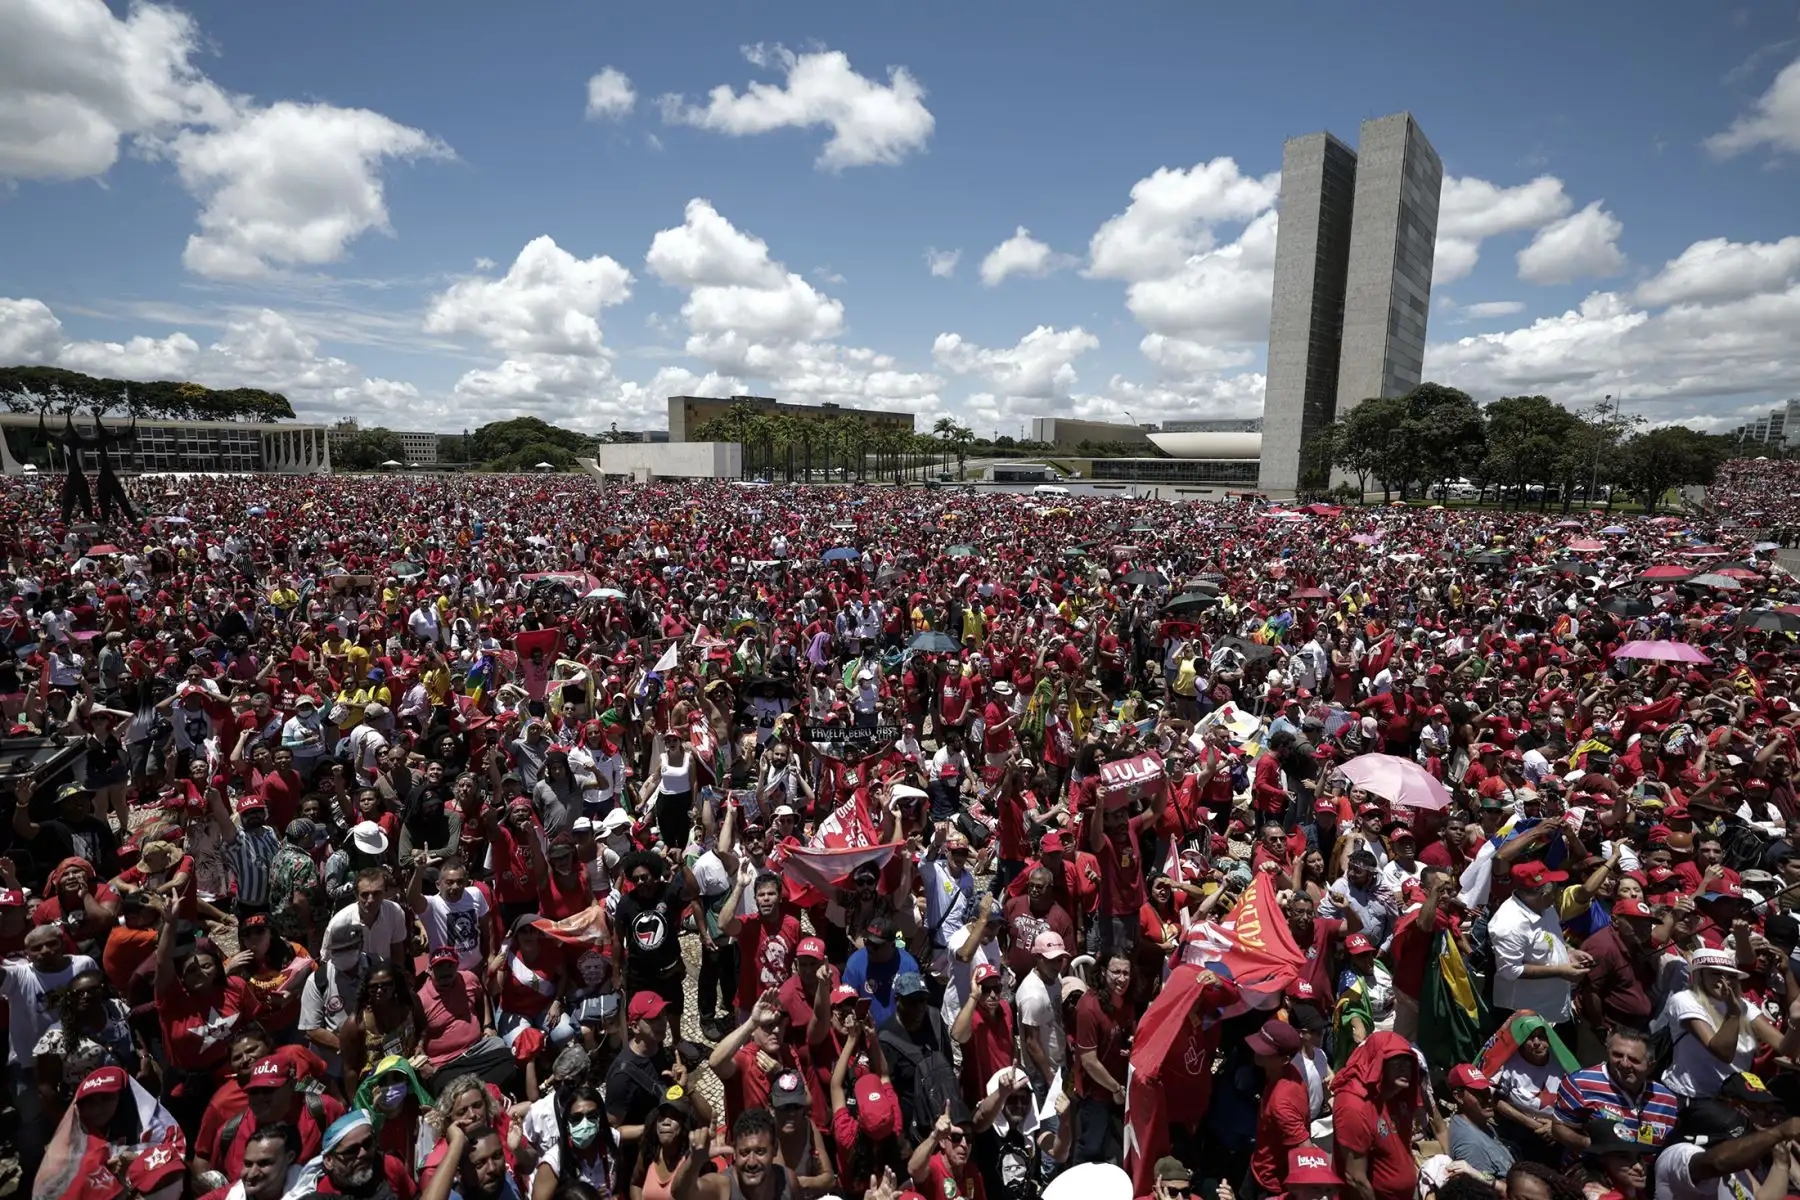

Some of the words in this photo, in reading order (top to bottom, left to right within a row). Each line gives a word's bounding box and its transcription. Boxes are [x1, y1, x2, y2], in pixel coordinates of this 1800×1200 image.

[811, 728, 846, 739] FAVELA
[1103, 756, 1161, 783] LULA
[241, 798, 259, 808] LULA
[1351, 937, 1367, 947] LULA
[803, 943, 819, 952] LULA
[253, 1064, 278, 1076] LULA
